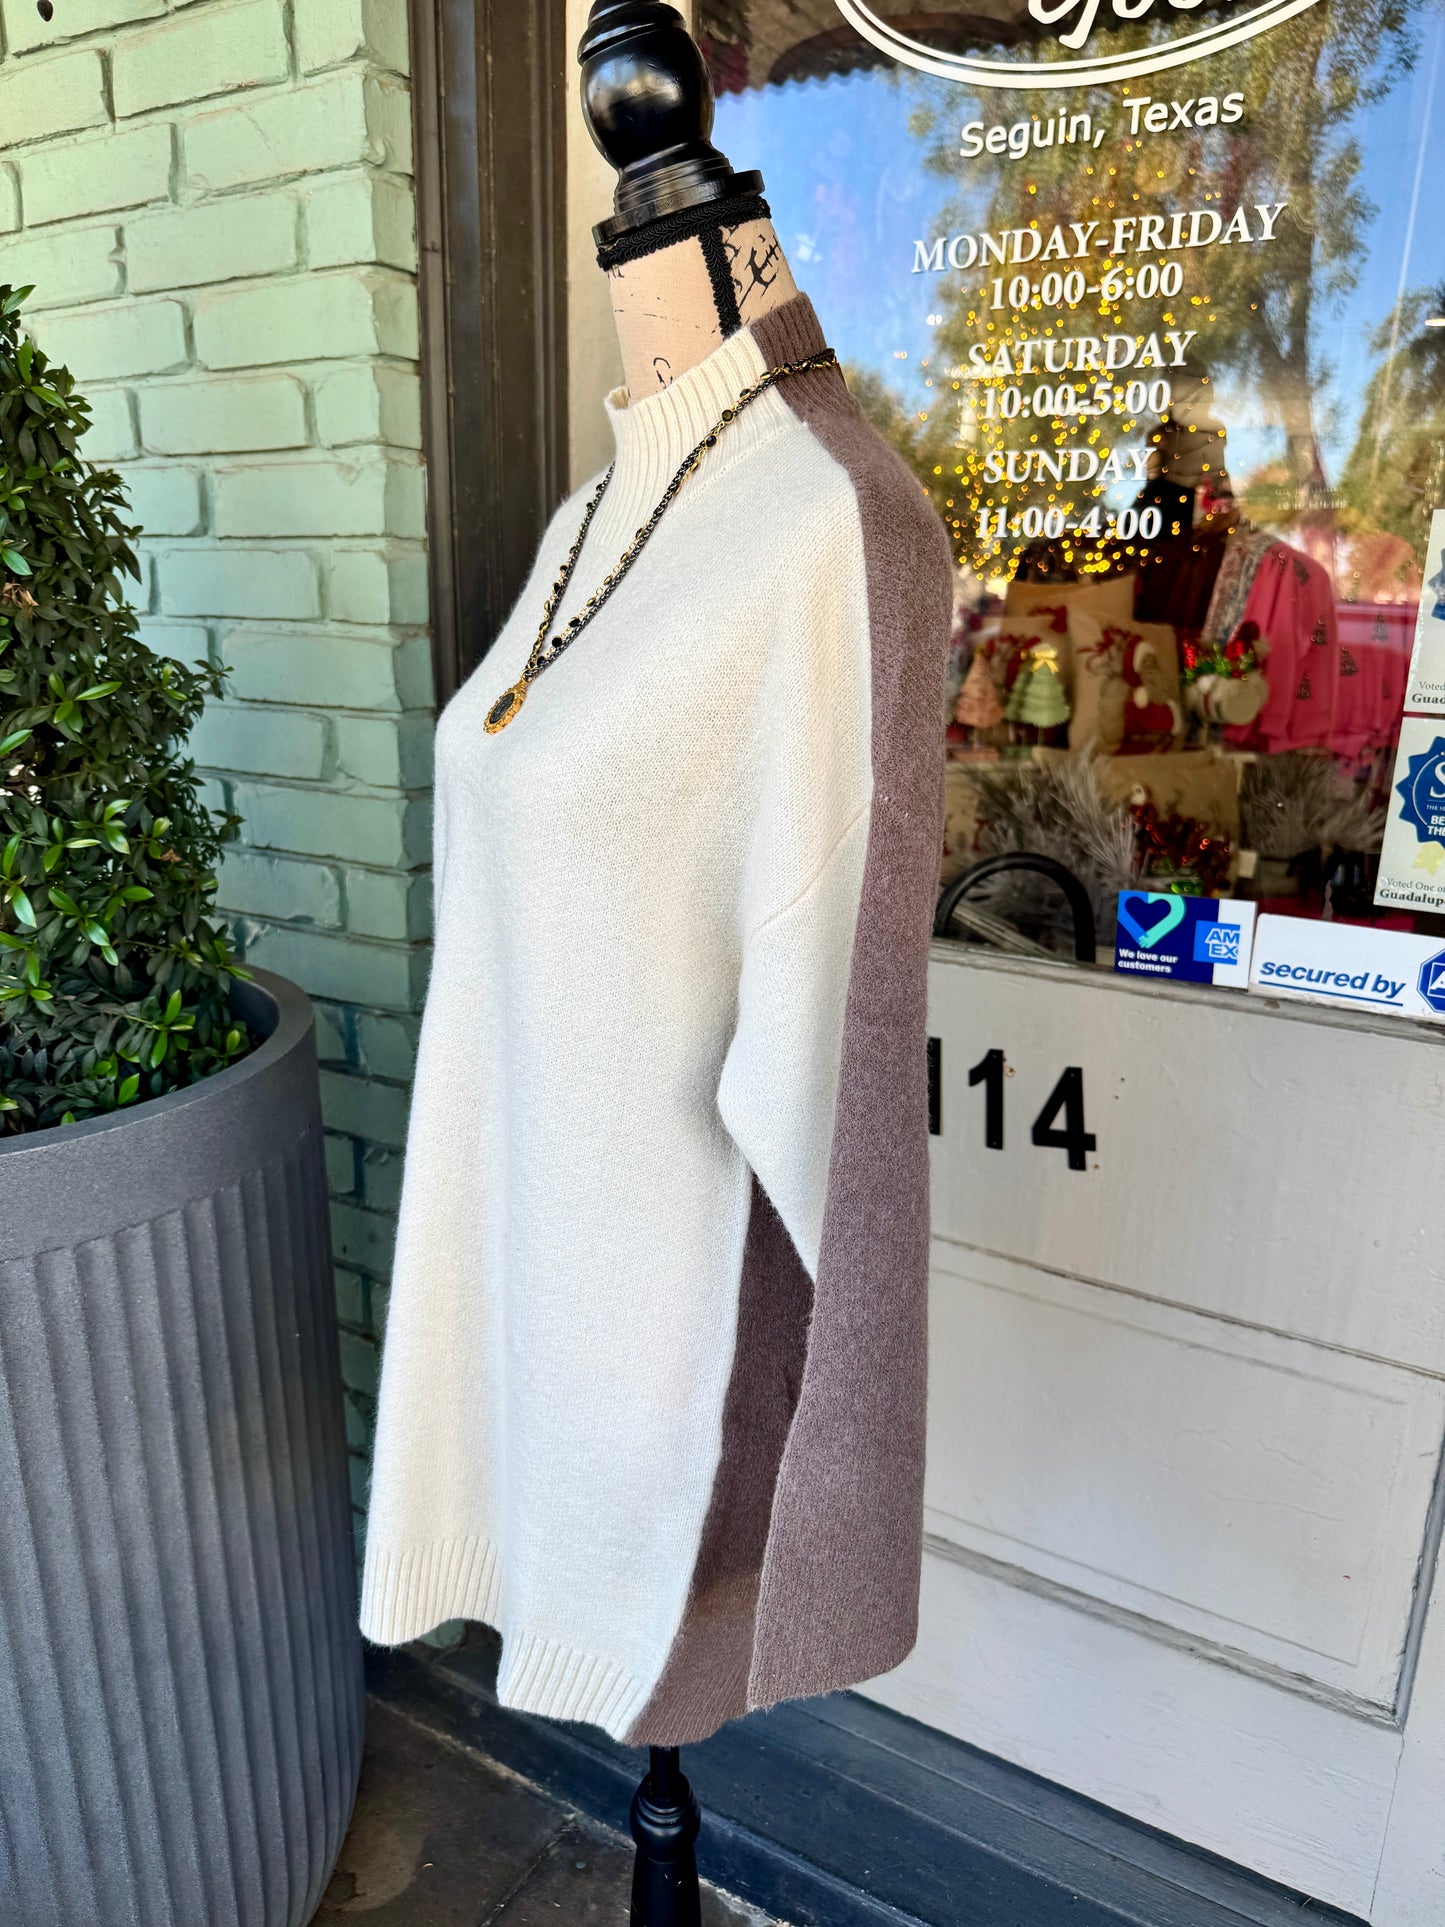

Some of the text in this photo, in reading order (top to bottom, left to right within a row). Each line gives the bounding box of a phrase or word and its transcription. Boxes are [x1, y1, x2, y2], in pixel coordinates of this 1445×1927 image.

[960, 92, 1244, 159] Seguin, Texas
[910, 202, 1288, 274] MONDAY-FRIDAY
[988, 261, 1184, 310] 10:00-6:00
[968, 330, 1198, 378] SATURDAY
[981, 379, 1172, 420] 10:00-5:00
[983, 447, 1157, 484] SUNDAY
[976, 506, 1163, 540] 11:00-4:00
[1379, 888, 1445, 907] Guadalup
[1387, 878, 1413, 889] Voted
[1415, 881, 1435, 891] One
[1118, 960, 1172, 974] customers
[1119, 948, 1178, 964] We love our
[1260, 961, 1370, 990] secured
[1371, 974, 1406, 999] by
